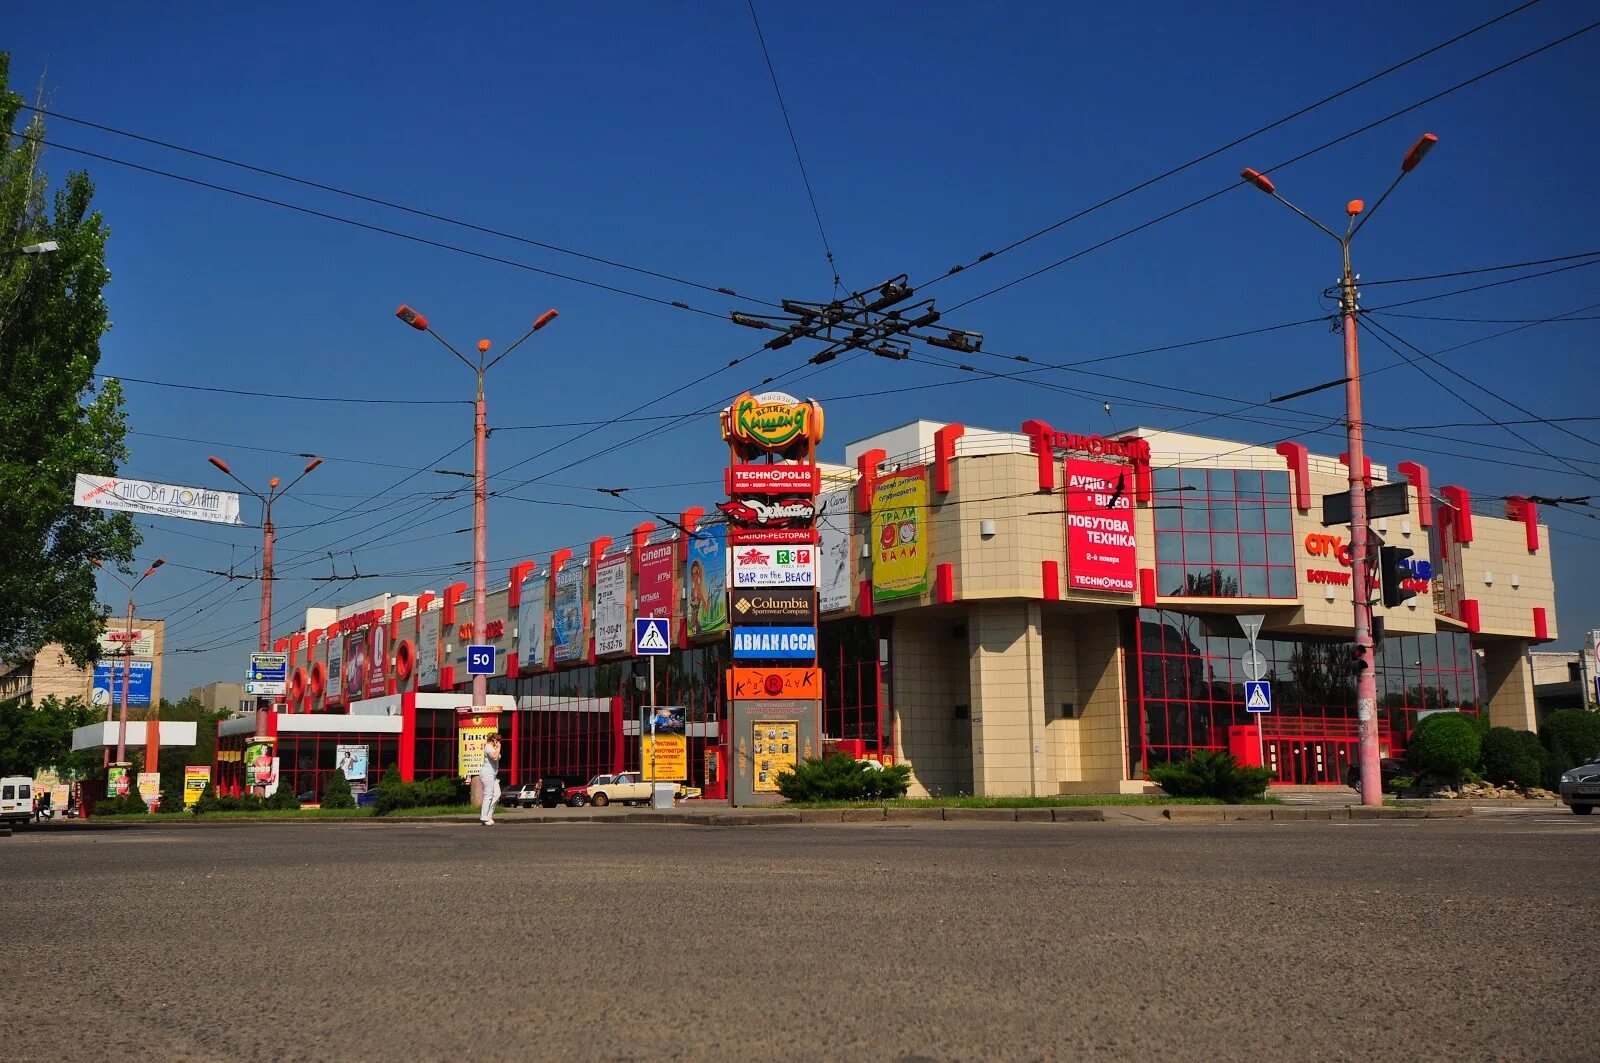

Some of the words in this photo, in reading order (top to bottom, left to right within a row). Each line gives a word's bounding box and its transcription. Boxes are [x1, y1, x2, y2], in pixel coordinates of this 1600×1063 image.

[756, 405, 791, 417] ВЕЛИКА
[735, 470, 812, 481] TECHNOPOLIS
[1069, 474, 1106, 491] АУДІО
[113, 482, 166, 503] СНІГОВА
[168, 488, 220, 509] ДОЛИНА
[1067, 514, 1130, 532] ПОБУТОВА
[1087, 531, 1136, 547] ТЕХНІКА
[641, 545, 672, 562] cinema
[881, 545, 918, 563] ВАЛИ
[657, 571, 671, 582] ИГРЫ
[738, 572, 756, 584] BAR
[770, 571, 782, 579] the
[785, 571, 812, 583] BEACH
[1075, 575, 1134, 589] TECHNOPOLIS
[751, 597, 809, 609] Columbia
[734, 633, 816, 651] АВИАКАССА
[473, 653, 490, 666] 50
[462, 733, 487, 741] Такс
